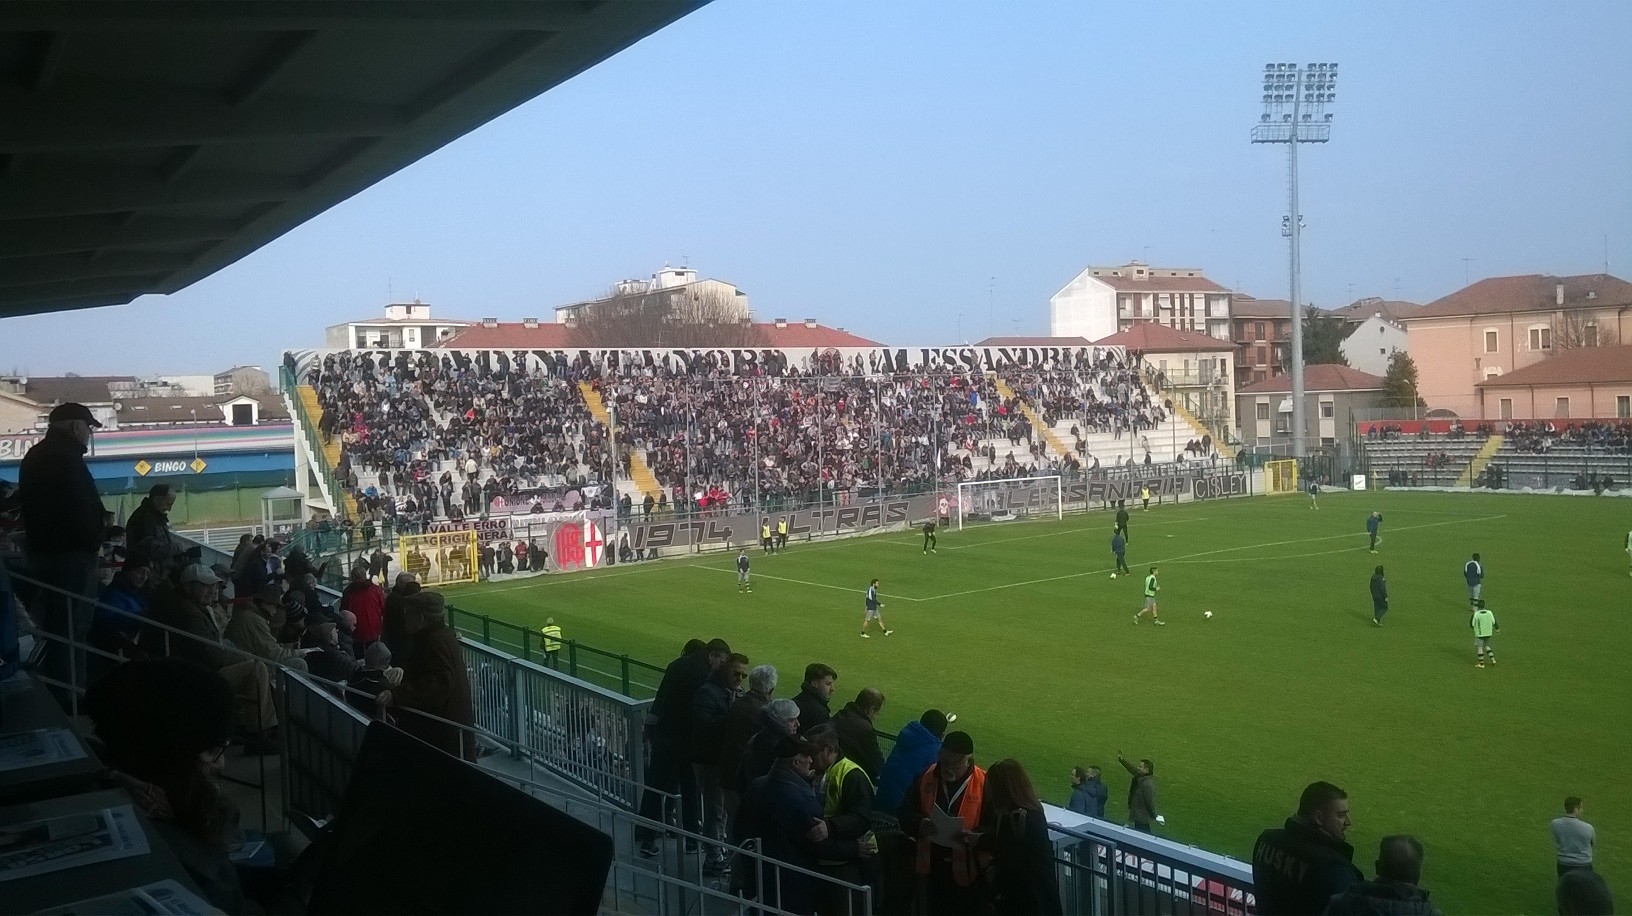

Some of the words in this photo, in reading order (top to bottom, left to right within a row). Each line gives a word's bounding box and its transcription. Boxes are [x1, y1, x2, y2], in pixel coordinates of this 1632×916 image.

[154, 461, 187, 472] BINGO
[1195, 473, 1247, 498] CISLEY
[430, 523, 469, 534] VALLE
[474, 520, 507, 531] ERRO
[632, 519, 733, 550] 1974
[761, 501, 910, 536] ULTRAS
[1256, 841, 1309, 882] HUSKY
